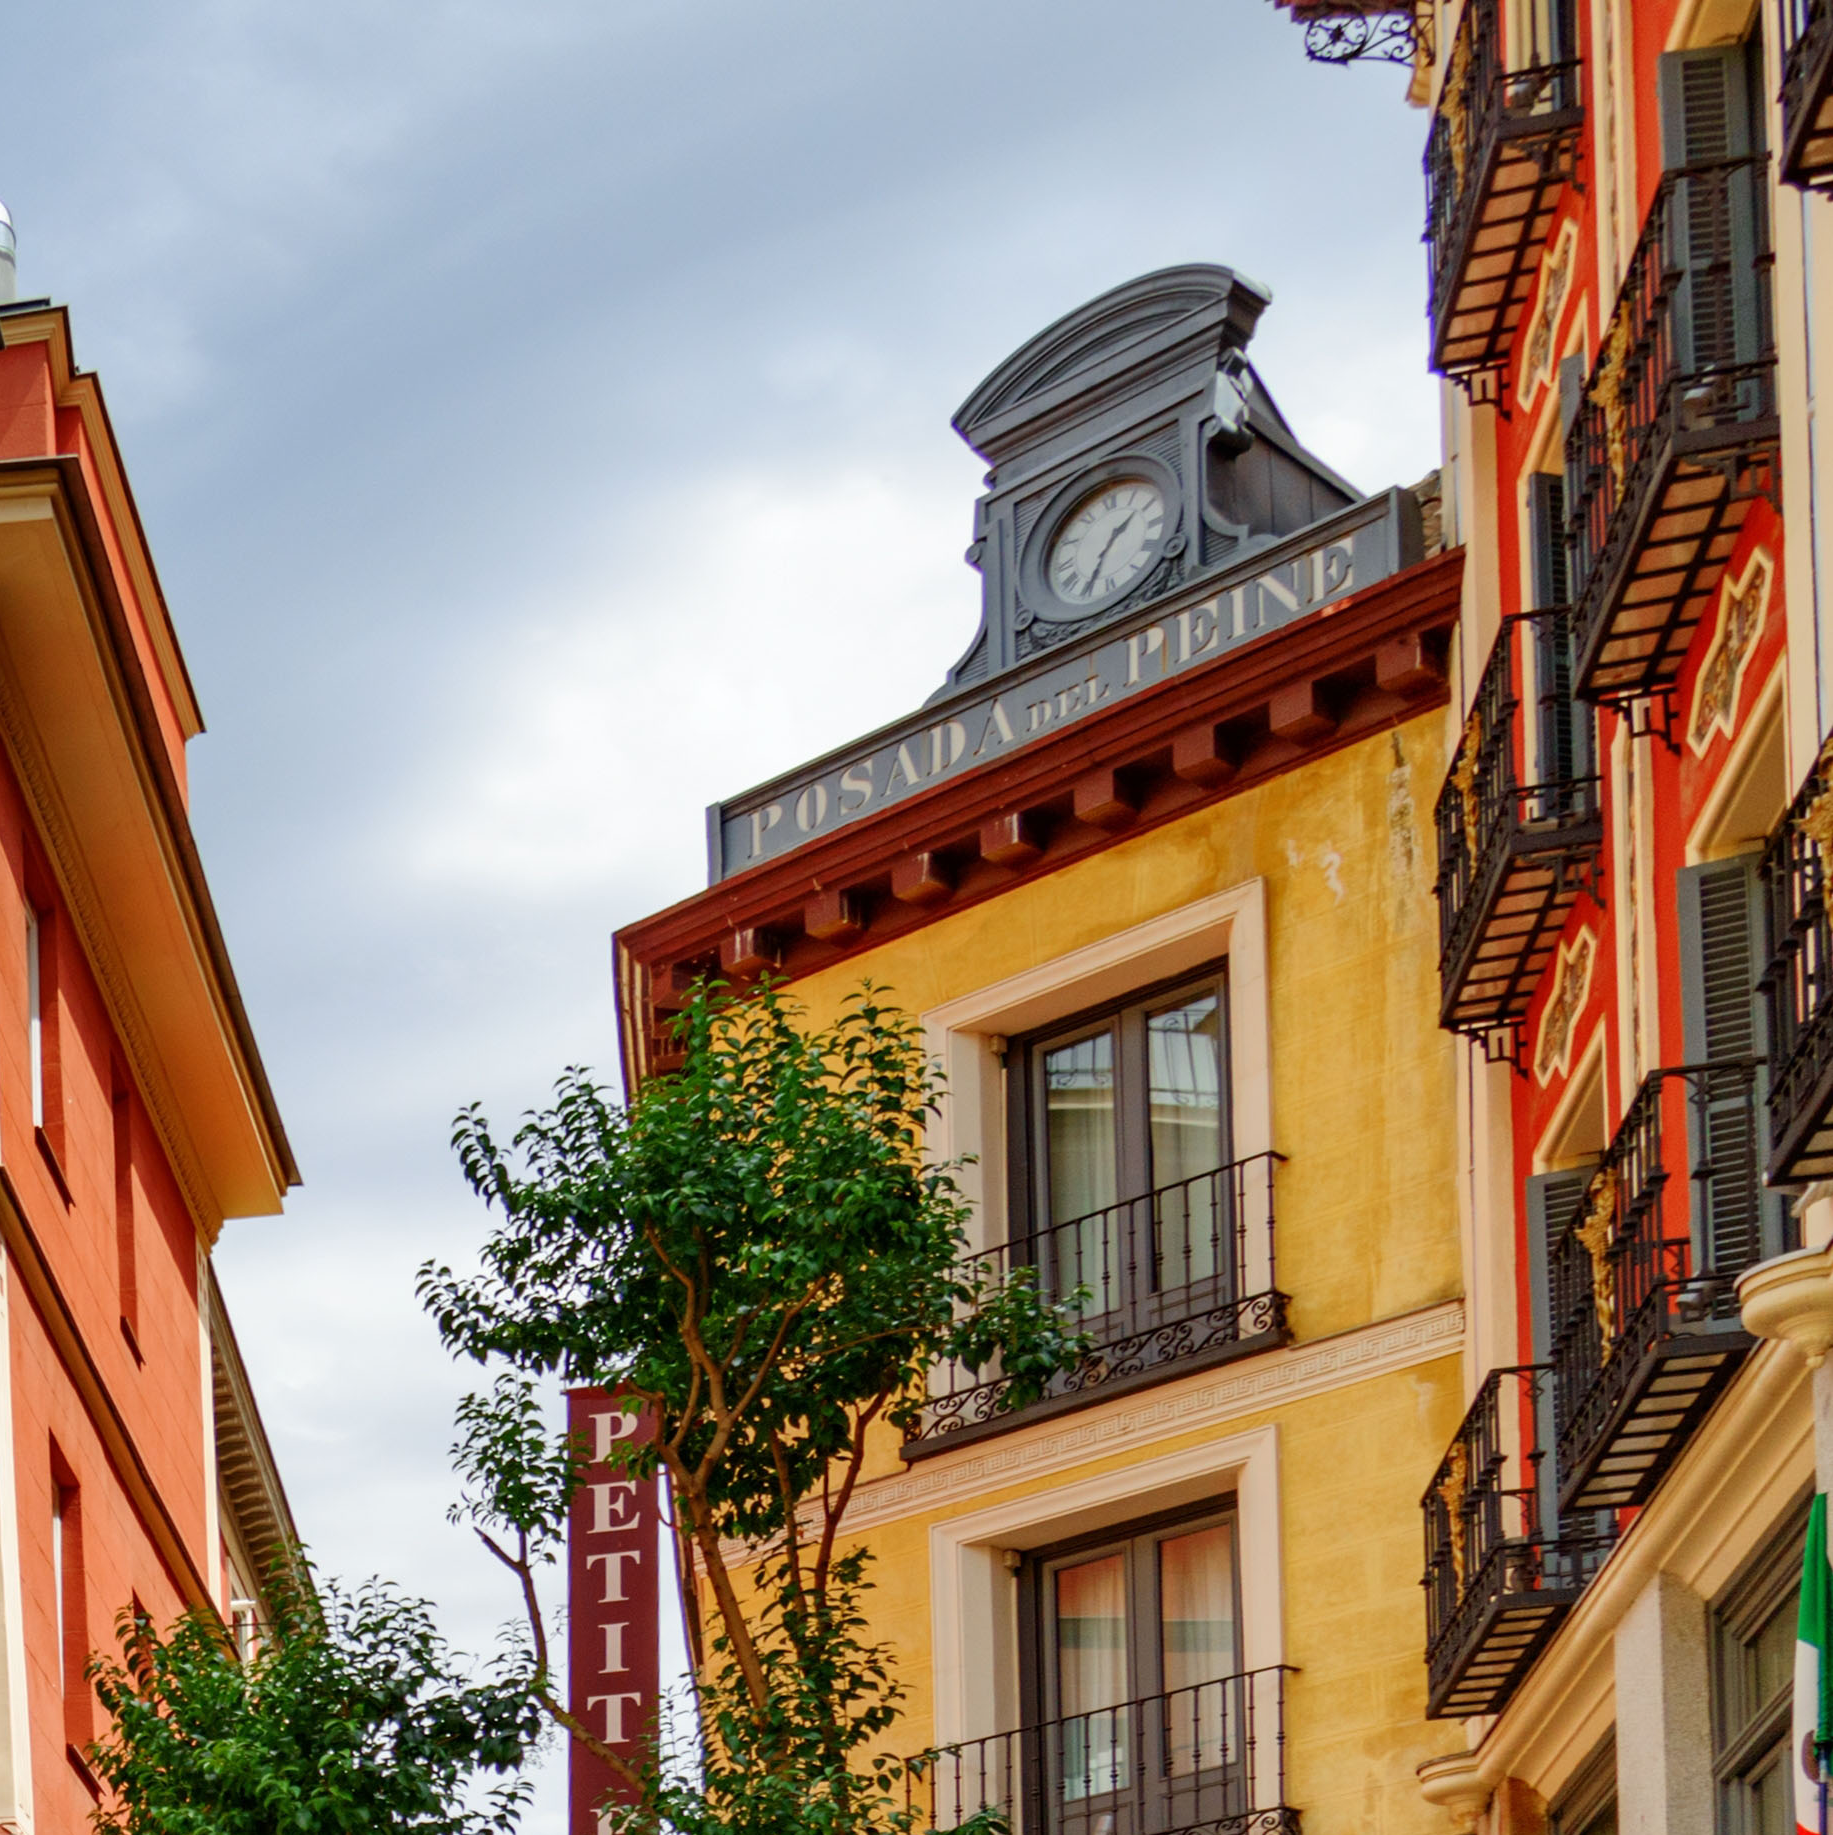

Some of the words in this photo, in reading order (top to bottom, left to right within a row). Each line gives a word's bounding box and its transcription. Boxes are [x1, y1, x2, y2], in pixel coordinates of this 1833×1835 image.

[746, 698, 1015, 859] POSADA
[1027, 675, 1113, 733] DEL
[1122, 536, 1355, 689] PEINE
[586, 1410, 641, 1745] PETIT
